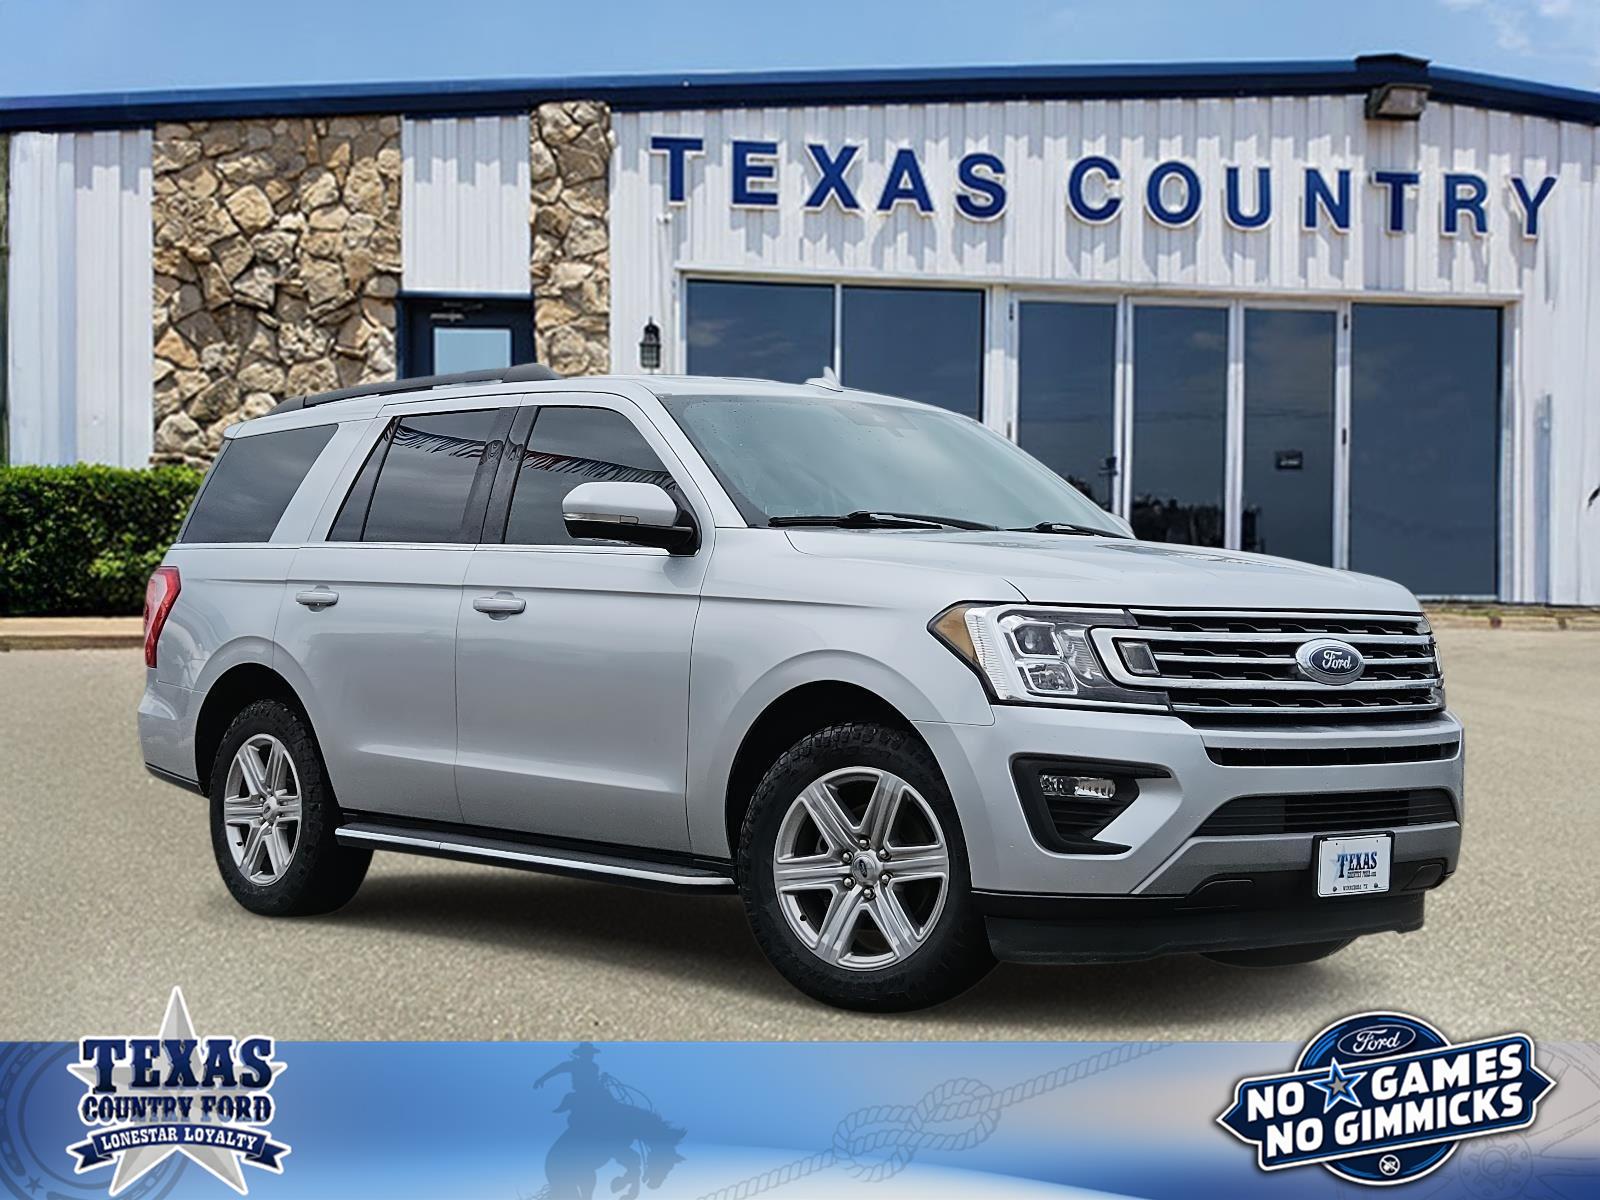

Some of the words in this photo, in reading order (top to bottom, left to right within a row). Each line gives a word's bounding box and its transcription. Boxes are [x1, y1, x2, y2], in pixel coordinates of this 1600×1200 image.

[651, 137, 1007, 219] TEXAS
[1068, 155, 1557, 236] COUNTRY
[1322, 650, 1352, 669] Ford
[1336, 851, 1377, 878] TEXAS
